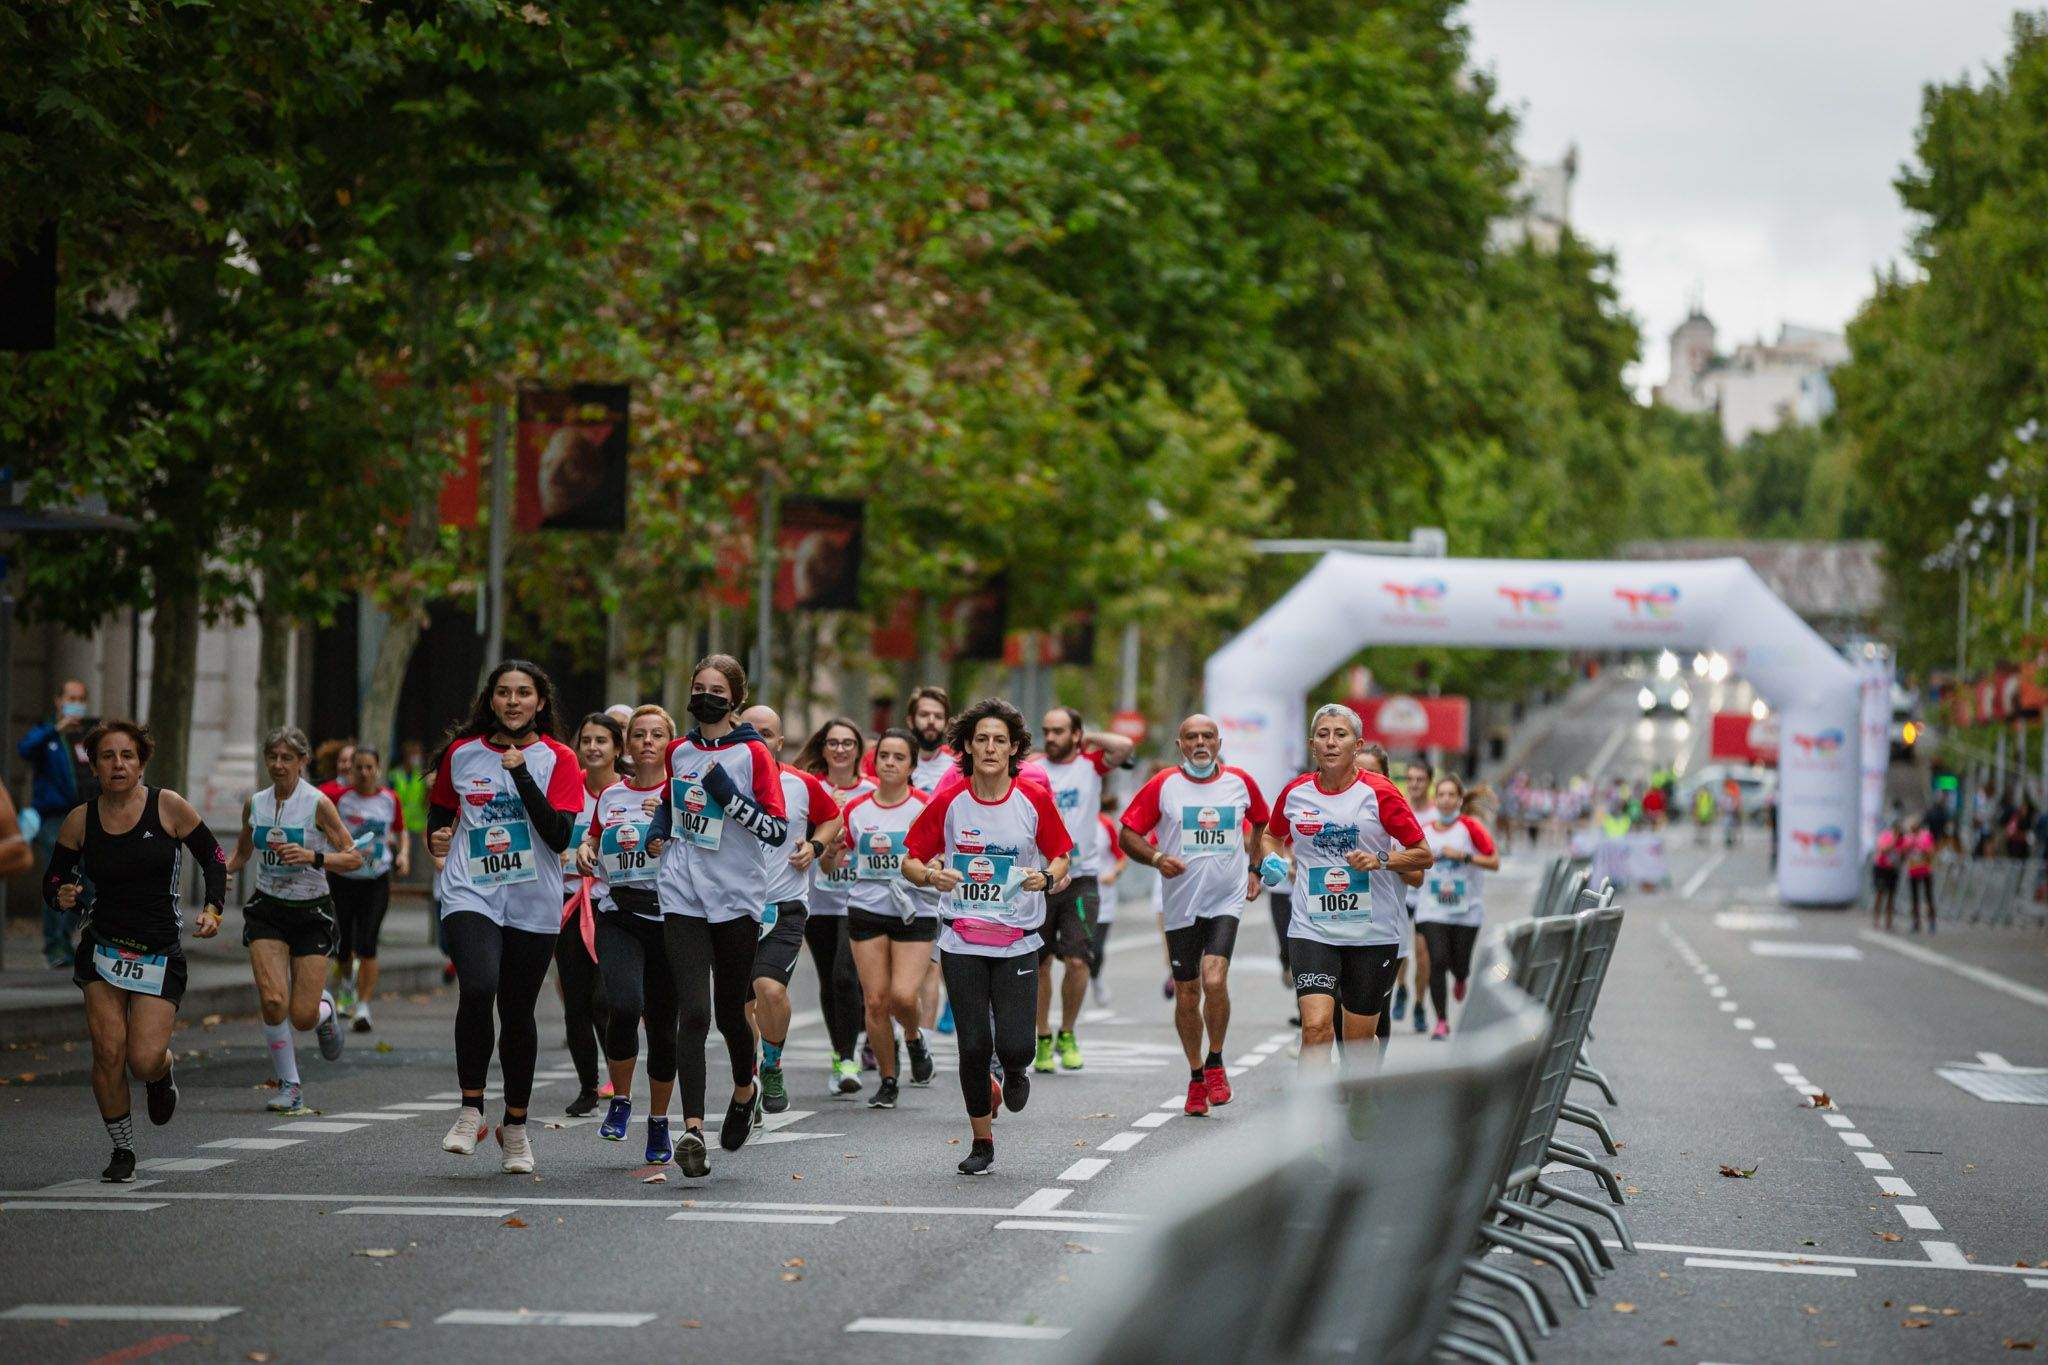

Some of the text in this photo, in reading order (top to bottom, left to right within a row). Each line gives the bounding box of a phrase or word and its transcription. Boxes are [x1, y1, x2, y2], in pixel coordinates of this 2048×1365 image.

[681, 811, 710, 835] 1047
[1194, 830, 1225, 845] 1075
[481, 852, 522, 874] 1044
[616, 851, 646, 870] 1078
[867, 855, 899, 870] 1033
[961, 883, 1001, 902] 1032
[1319, 893, 1359, 912] 1062
[111, 960, 144, 980] 475
